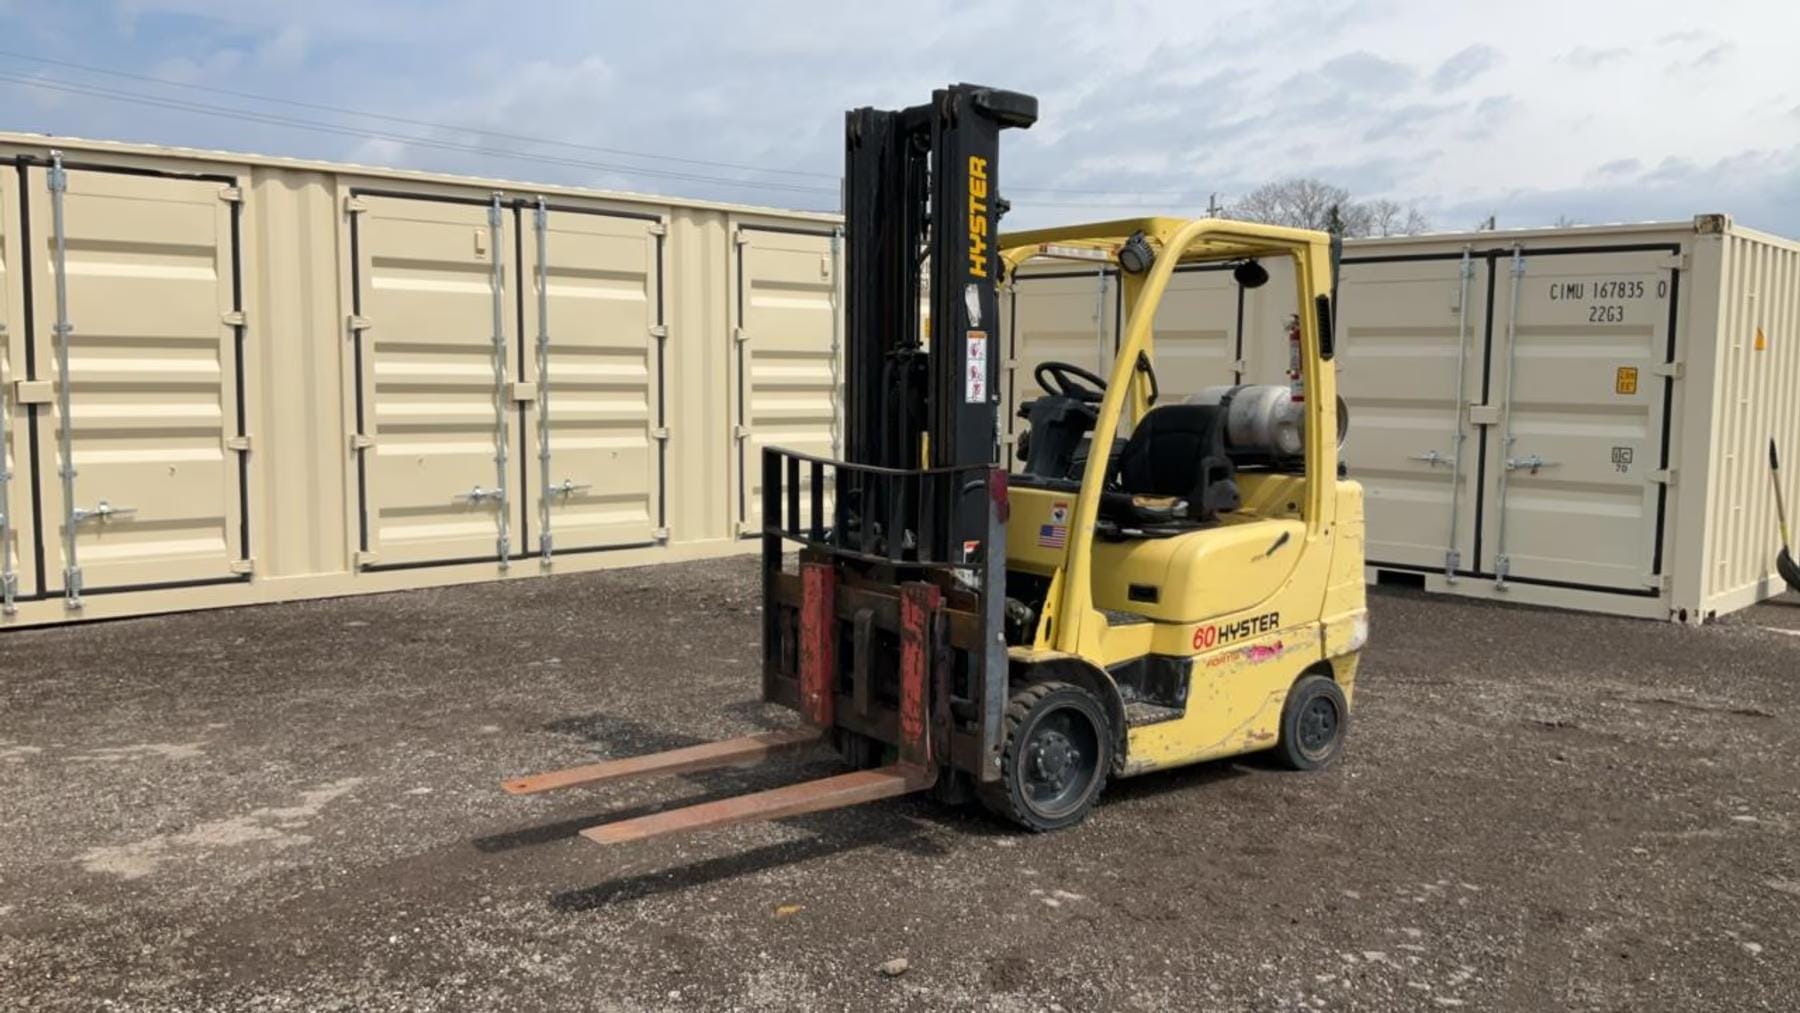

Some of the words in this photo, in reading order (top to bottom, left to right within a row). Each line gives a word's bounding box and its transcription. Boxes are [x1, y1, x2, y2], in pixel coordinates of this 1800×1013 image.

[968, 155, 988, 278] HYSTER
[1550, 283, 1584, 300] CIMU
[1593, 281, 1644, 299] 167835
[1657, 280, 1666, 299] 0
[1589, 305, 1624, 322] 22G3
[1193, 626, 1216, 650] 60
[1218, 612, 1280, 644] HYSTER
